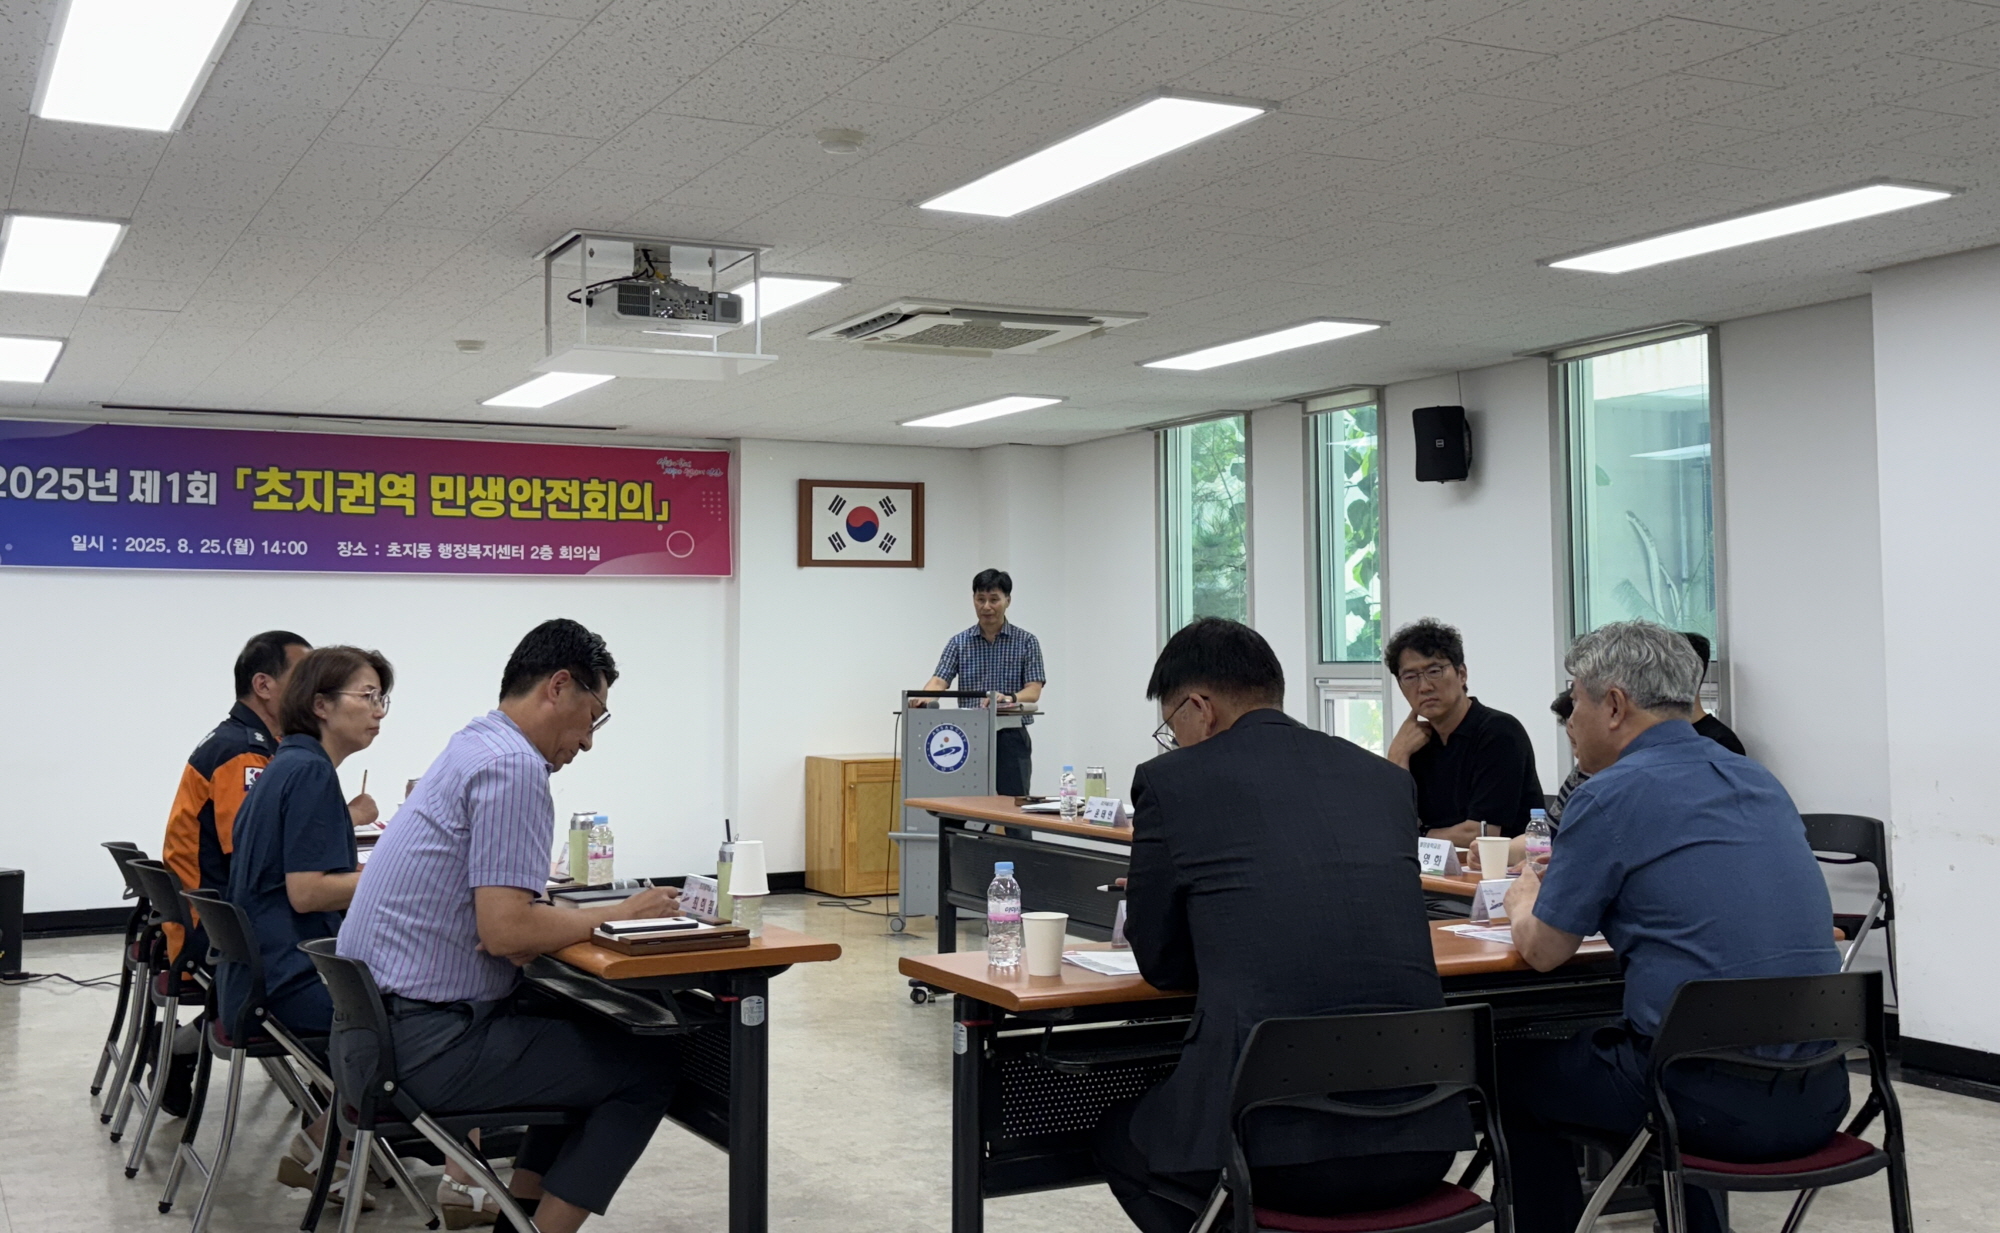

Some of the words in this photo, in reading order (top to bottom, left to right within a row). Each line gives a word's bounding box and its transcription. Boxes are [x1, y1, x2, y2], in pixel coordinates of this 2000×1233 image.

[0, 466, 118, 502] 2025년
[128, 469, 218, 506] 제1회
[71, 534, 104, 552] 일시
[125, 537, 171, 554] 2025.
[177, 538, 194, 554] 8.
[262, 539, 308, 556] 14:00
[337, 541, 368, 558] 장소
[386, 542, 433, 559] 초지동
[438, 542, 525, 560] 행정복지센터
[530, 544, 554, 561] 2층
[559, 545, 601, 561] 회의실
